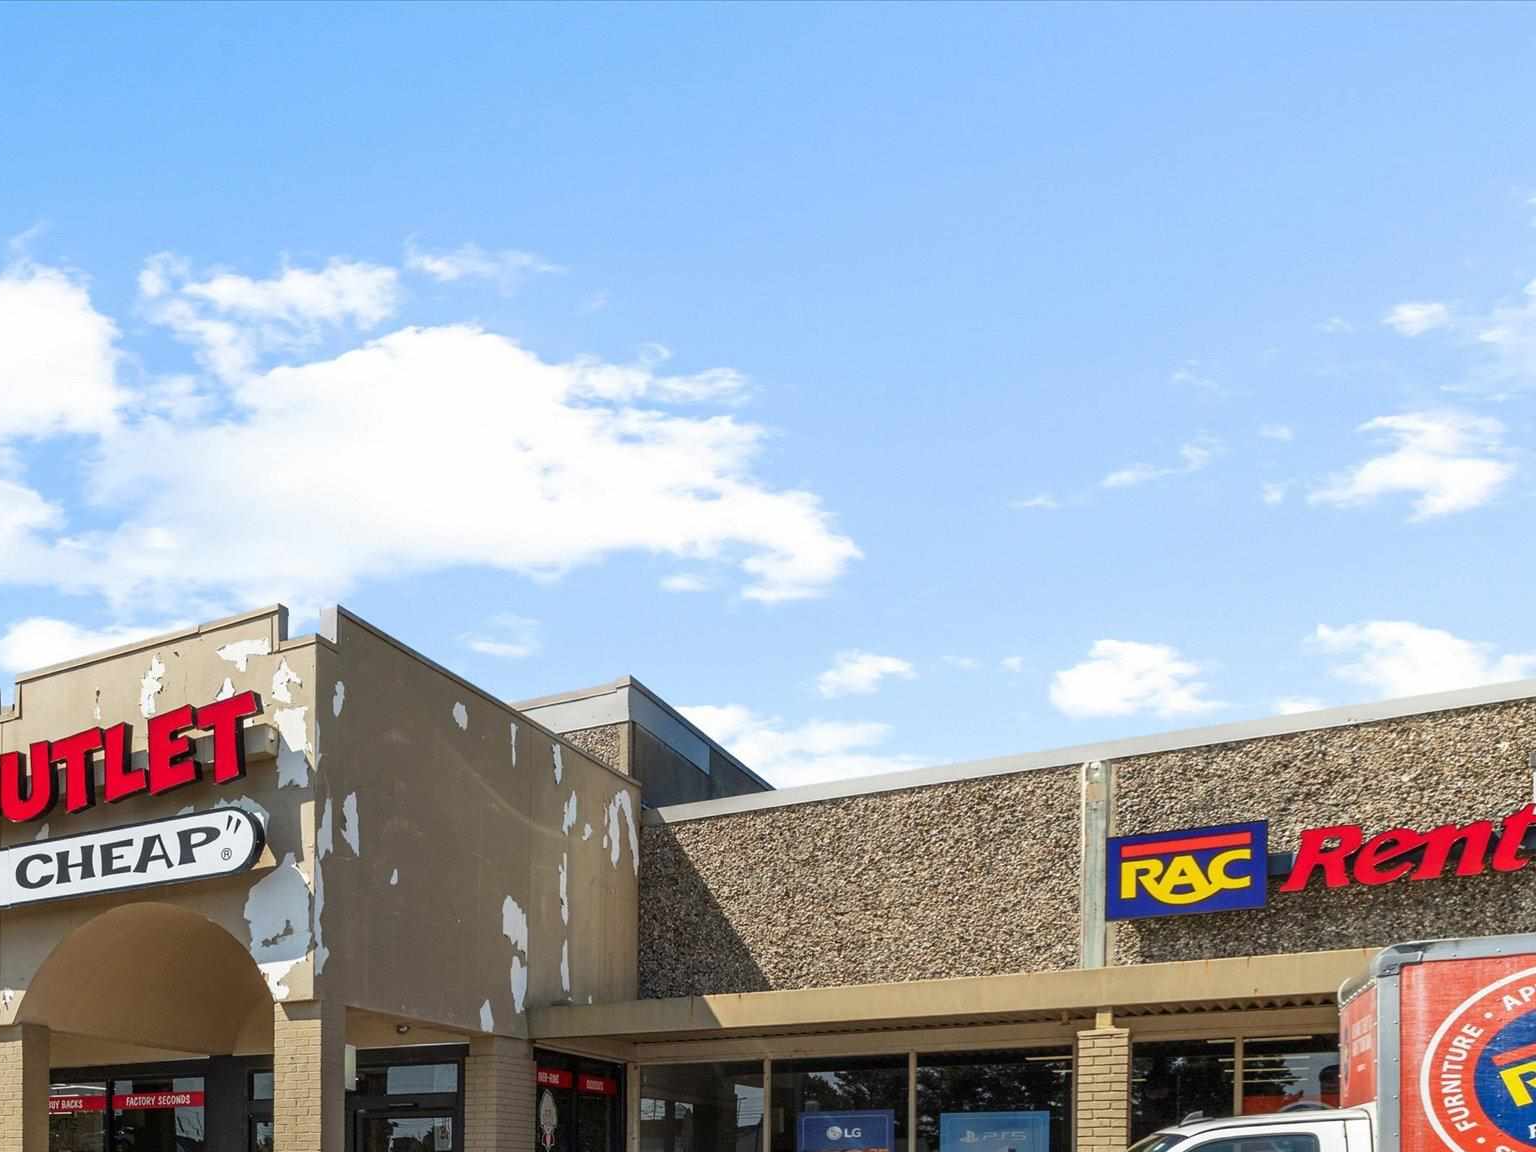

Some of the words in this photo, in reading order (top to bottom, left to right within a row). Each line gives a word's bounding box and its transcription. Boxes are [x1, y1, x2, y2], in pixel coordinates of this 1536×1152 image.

[1120, 849, 1252, 905] RAC
[1280, 802, 1536, 893] Rent
[1441, 1023, 1484, 1132] FURNITURE
[61, 1099, 83, 1109] BACKS
[126, 1096, 155, 1107] FACTORY
[158, 1094, 191, 1105] SECONDS
[844, 1127, 862, 1138] LG
